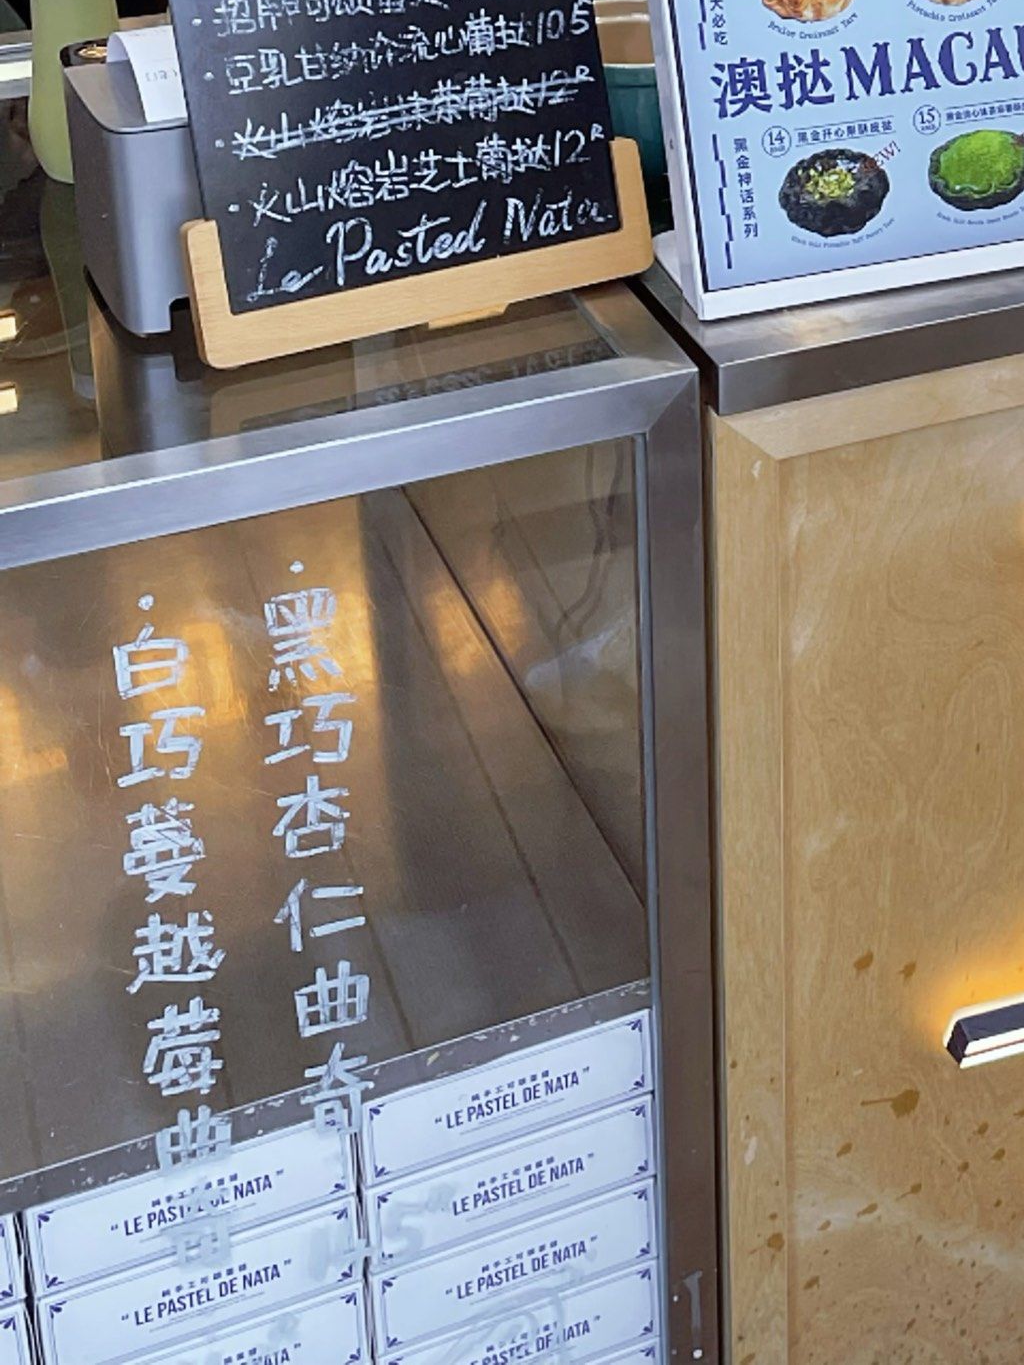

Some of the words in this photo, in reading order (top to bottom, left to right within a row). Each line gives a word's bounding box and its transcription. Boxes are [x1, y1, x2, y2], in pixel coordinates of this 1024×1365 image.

[710, 49, 836, 120] 澳挞
[768, 129, 785, 146] 14
[919, 106, 936, 124] 15
[733, 137, 758, 239] 黑金神话系列
[263, 586, 374, 1137] 黑巧杏仁曲奇
[467, 1091, 519, 1122] PASTEL
[522, 1084, 541, 1103] DE
[545, 1069, 579, 1095] NATA
[147, 1193, 205, 1229] PAST
[233, 1174, 272, 1201] NATA
[453, 1196, 470, 1216] LE
[473, 1177, 525, 1208] PASTEL
[528, 1170, 546, 1189] DE
[550, 1157, 584, 1182] NATA
[157, 1287, 214, 1318] PASTEL
[218, 1278, 238, 1299] DE
[242, 1264, 281, 1291] NATA
[477, 1261, 528, 1292] PASTEL
[531, 1255, 549, 1273] DE
[552, 1240, 586, 1265] NATA
